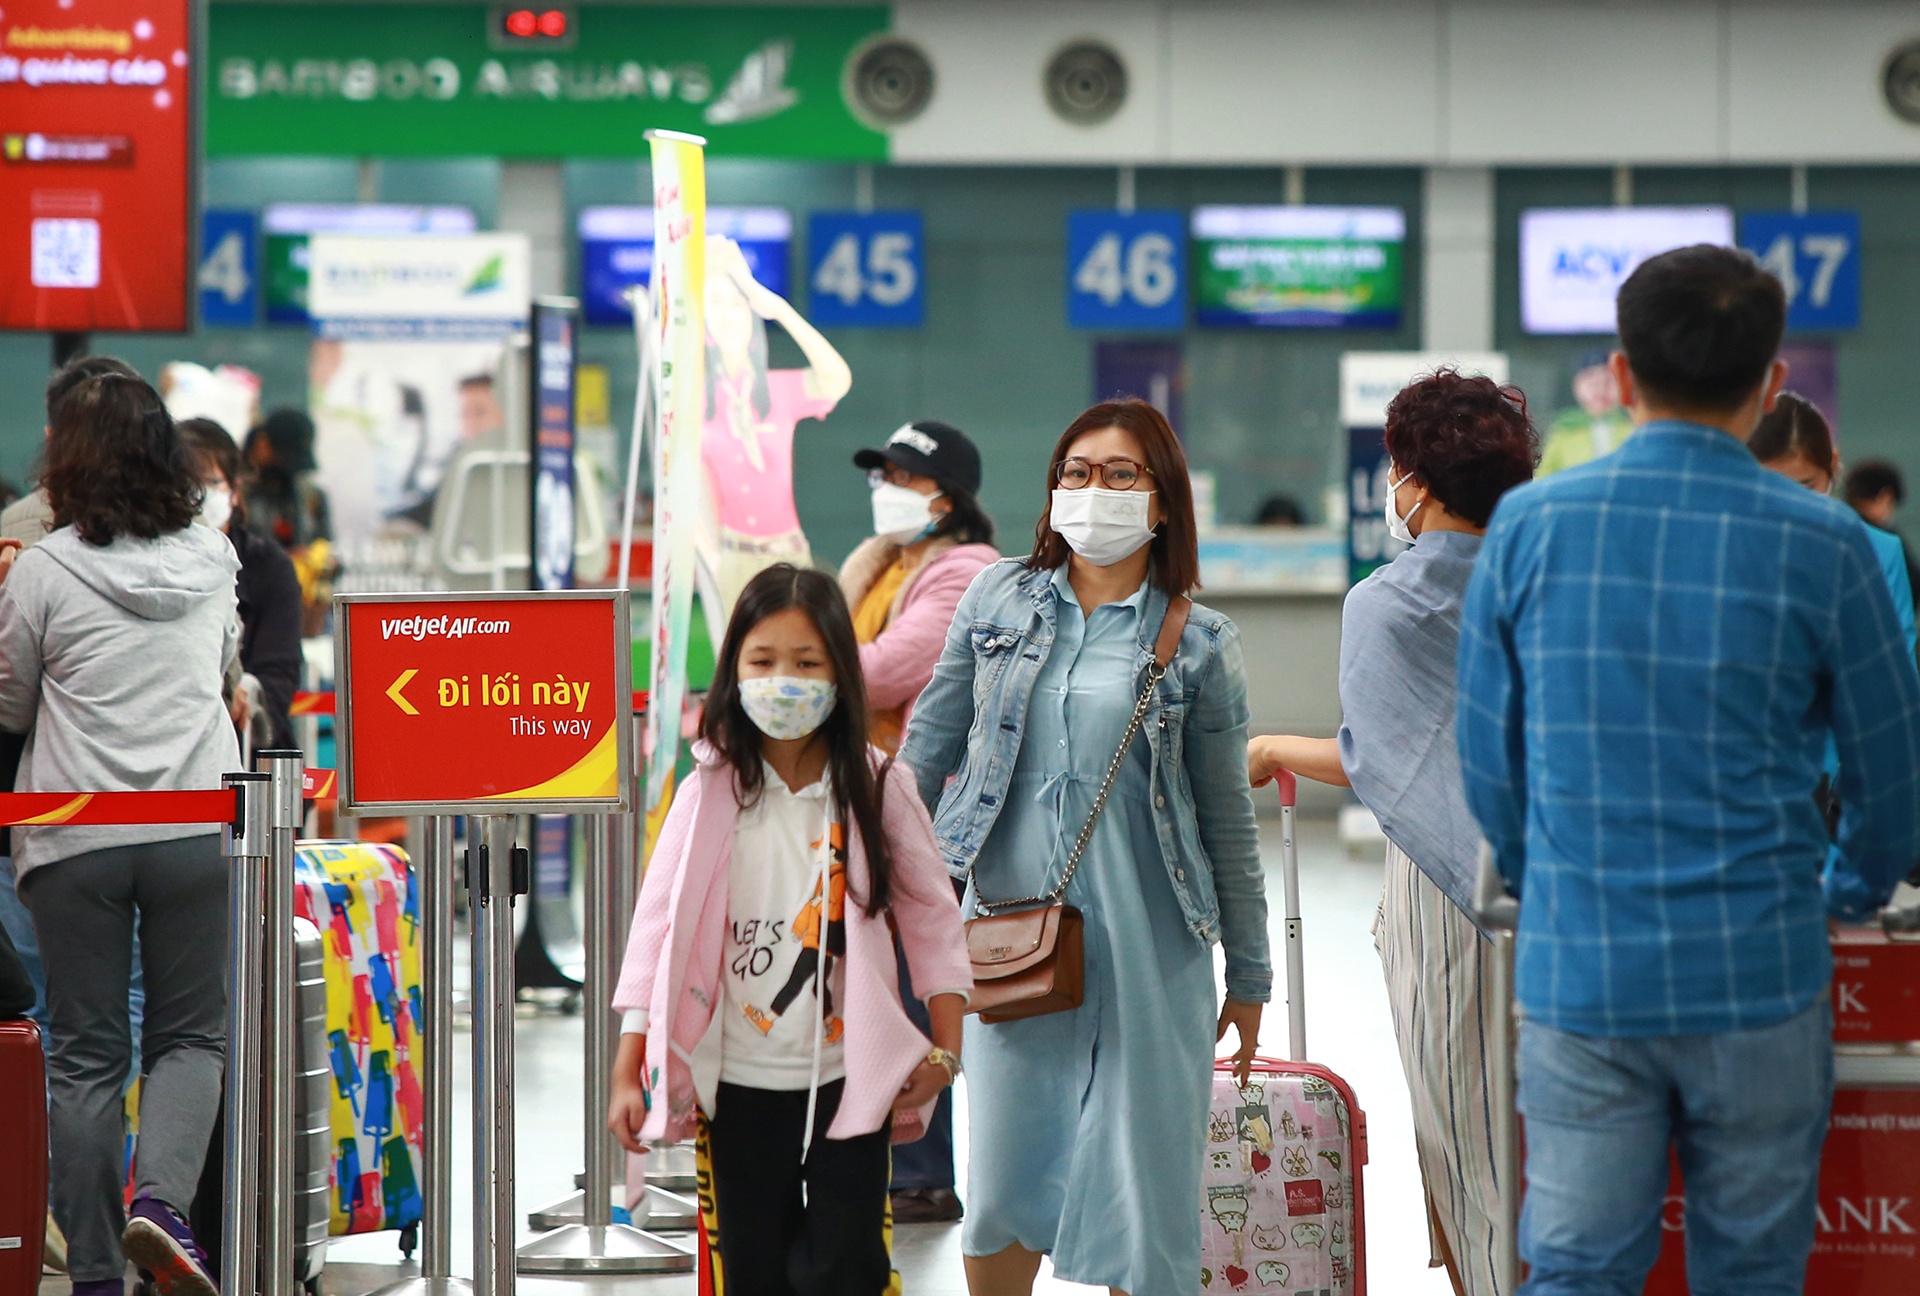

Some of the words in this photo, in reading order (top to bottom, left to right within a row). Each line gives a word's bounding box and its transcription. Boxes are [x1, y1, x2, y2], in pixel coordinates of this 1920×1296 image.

[217, 56, 460, 101] BAMBOO
[474, 58, 712, 103] AIRWAYS
[811, 230, 918, 307] 45
[1074, 231, 1177, 308] 46
[438, 675, 469, 707] Đi
[482, 672, 520, 706] lối
[532, 673, 591, 713] này
[509, 714, 546, 736] This
[552, 719, 592, 740] way
[732, 919, 785, 946] LET'S
[732, 946, 773, 981] GO
